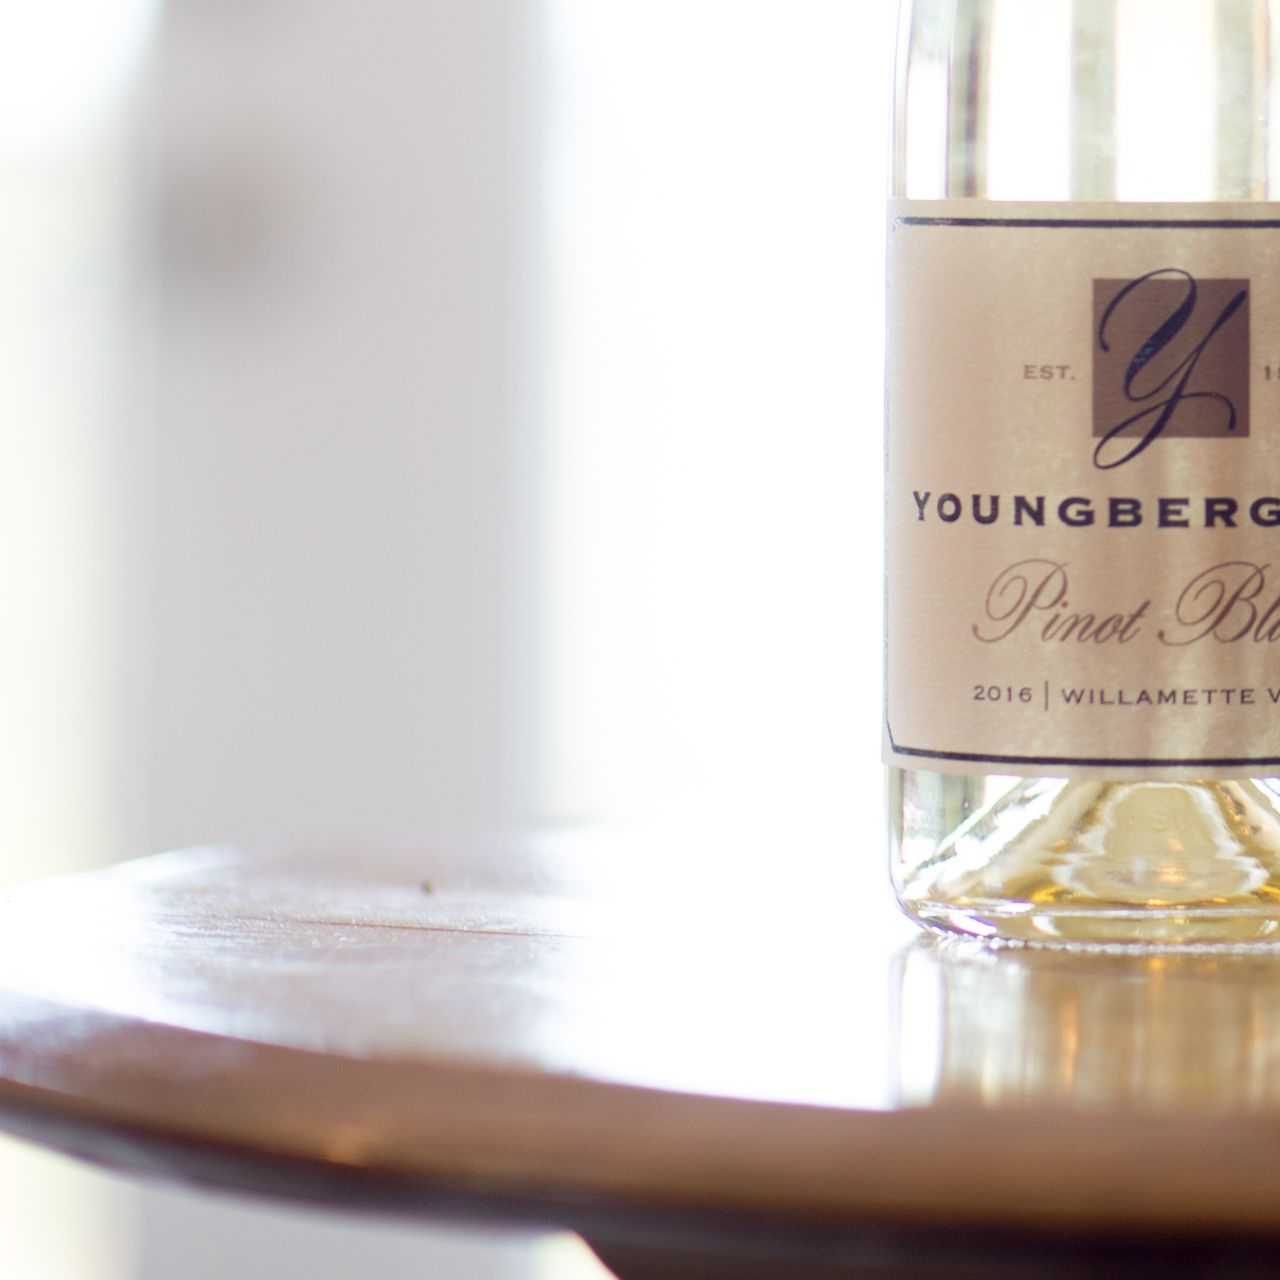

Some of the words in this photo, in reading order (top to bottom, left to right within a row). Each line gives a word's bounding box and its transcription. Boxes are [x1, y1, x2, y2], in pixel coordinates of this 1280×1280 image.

[1023, 364, 1076, 381] EST.
[1092, 267, 1248, 470] Y
[971, 558, 1152, 644] Pinot
[972, 683, 1034, 704] 2016
[1060, 687, 1256, 706] WILLAMETTE
